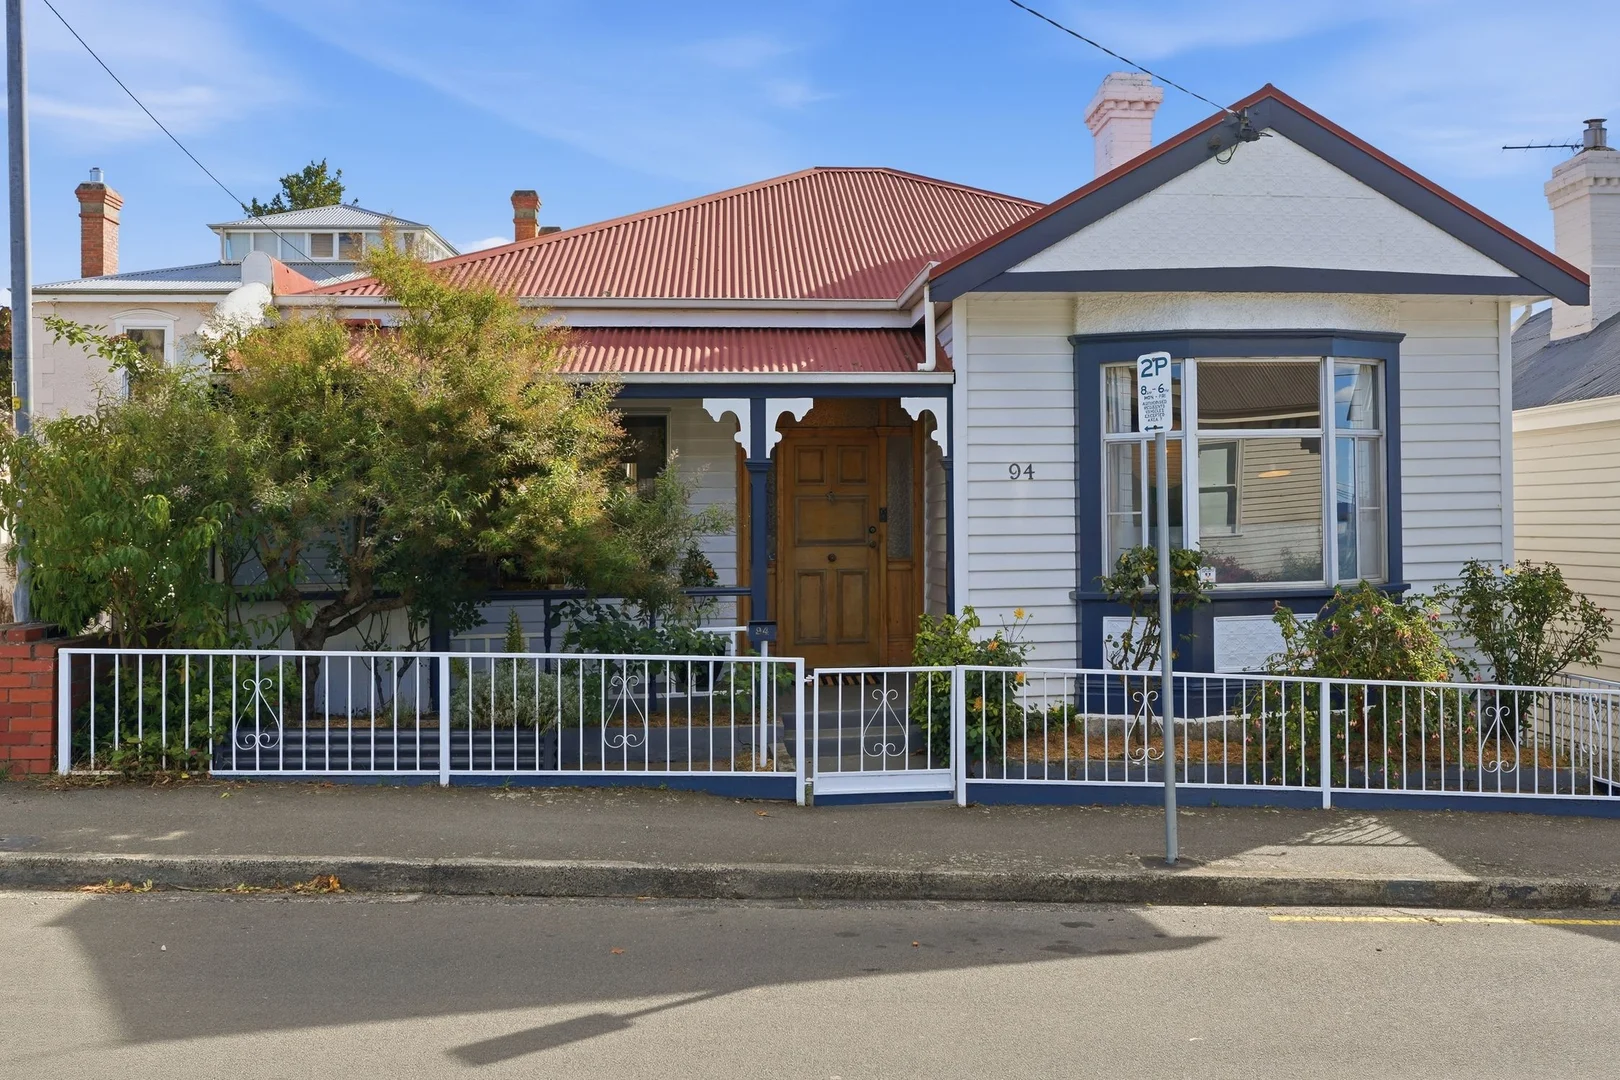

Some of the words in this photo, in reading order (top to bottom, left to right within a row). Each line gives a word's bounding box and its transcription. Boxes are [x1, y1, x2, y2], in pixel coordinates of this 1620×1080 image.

[1140, 356, 1168, 378] 2P
[1009, 463, 1036, 480] 94
[755, 626, 769, 635] 94
